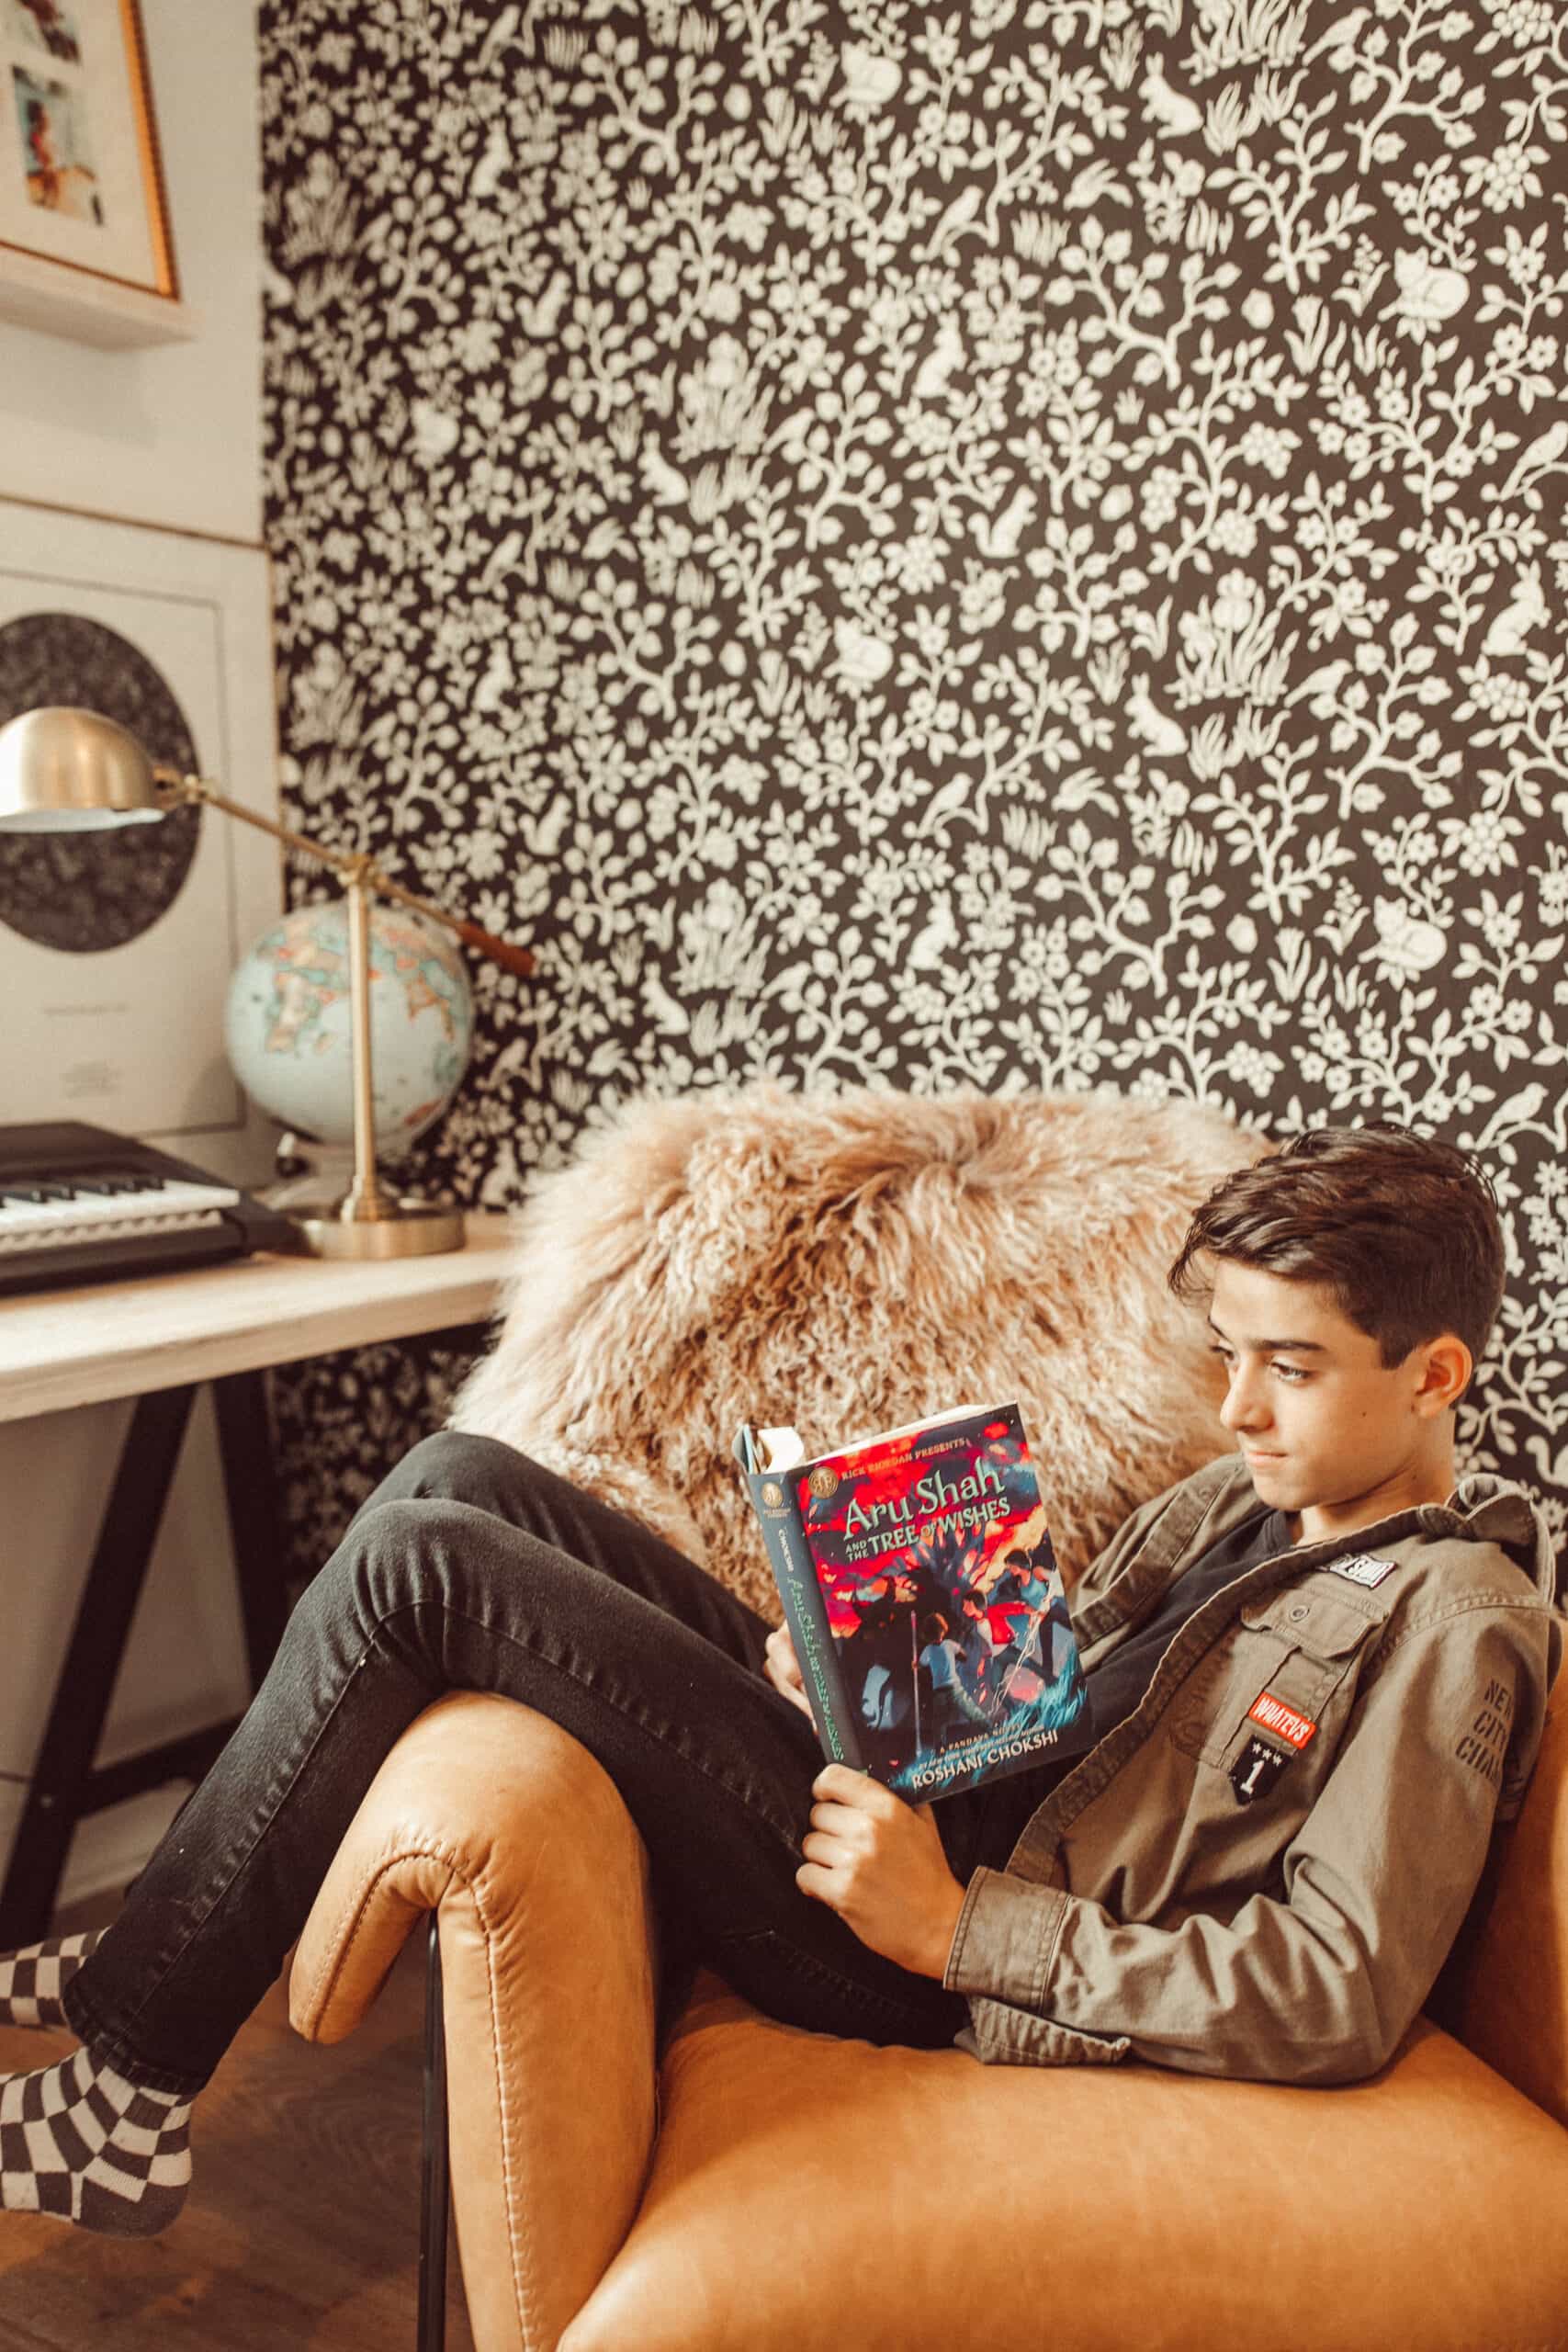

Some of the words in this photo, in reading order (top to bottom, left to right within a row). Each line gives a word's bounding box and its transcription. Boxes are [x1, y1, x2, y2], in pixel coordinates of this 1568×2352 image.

[841, 1466, 865, 1481] RICK
[915, 1438, 965, 1460] PRESENTS
[843, 1497, 915, 1541] Aru
[917, 1455, 1006, 1515] Shah
[938, 1496, 1011, 1535] WISHES
[846, 1539, 867, 1555] AND
[848, 1549, 869, 1563] THE
[867, 1523, 919, 1555] TREE
[1252, 1696, 1311, 1742] WHATEVS
[911, 1754, 983, 1790] ROSHANI
[987, 1729, 1059, 1764] CHOKSHI
[1239, 1759, 1265, 1795] 1
